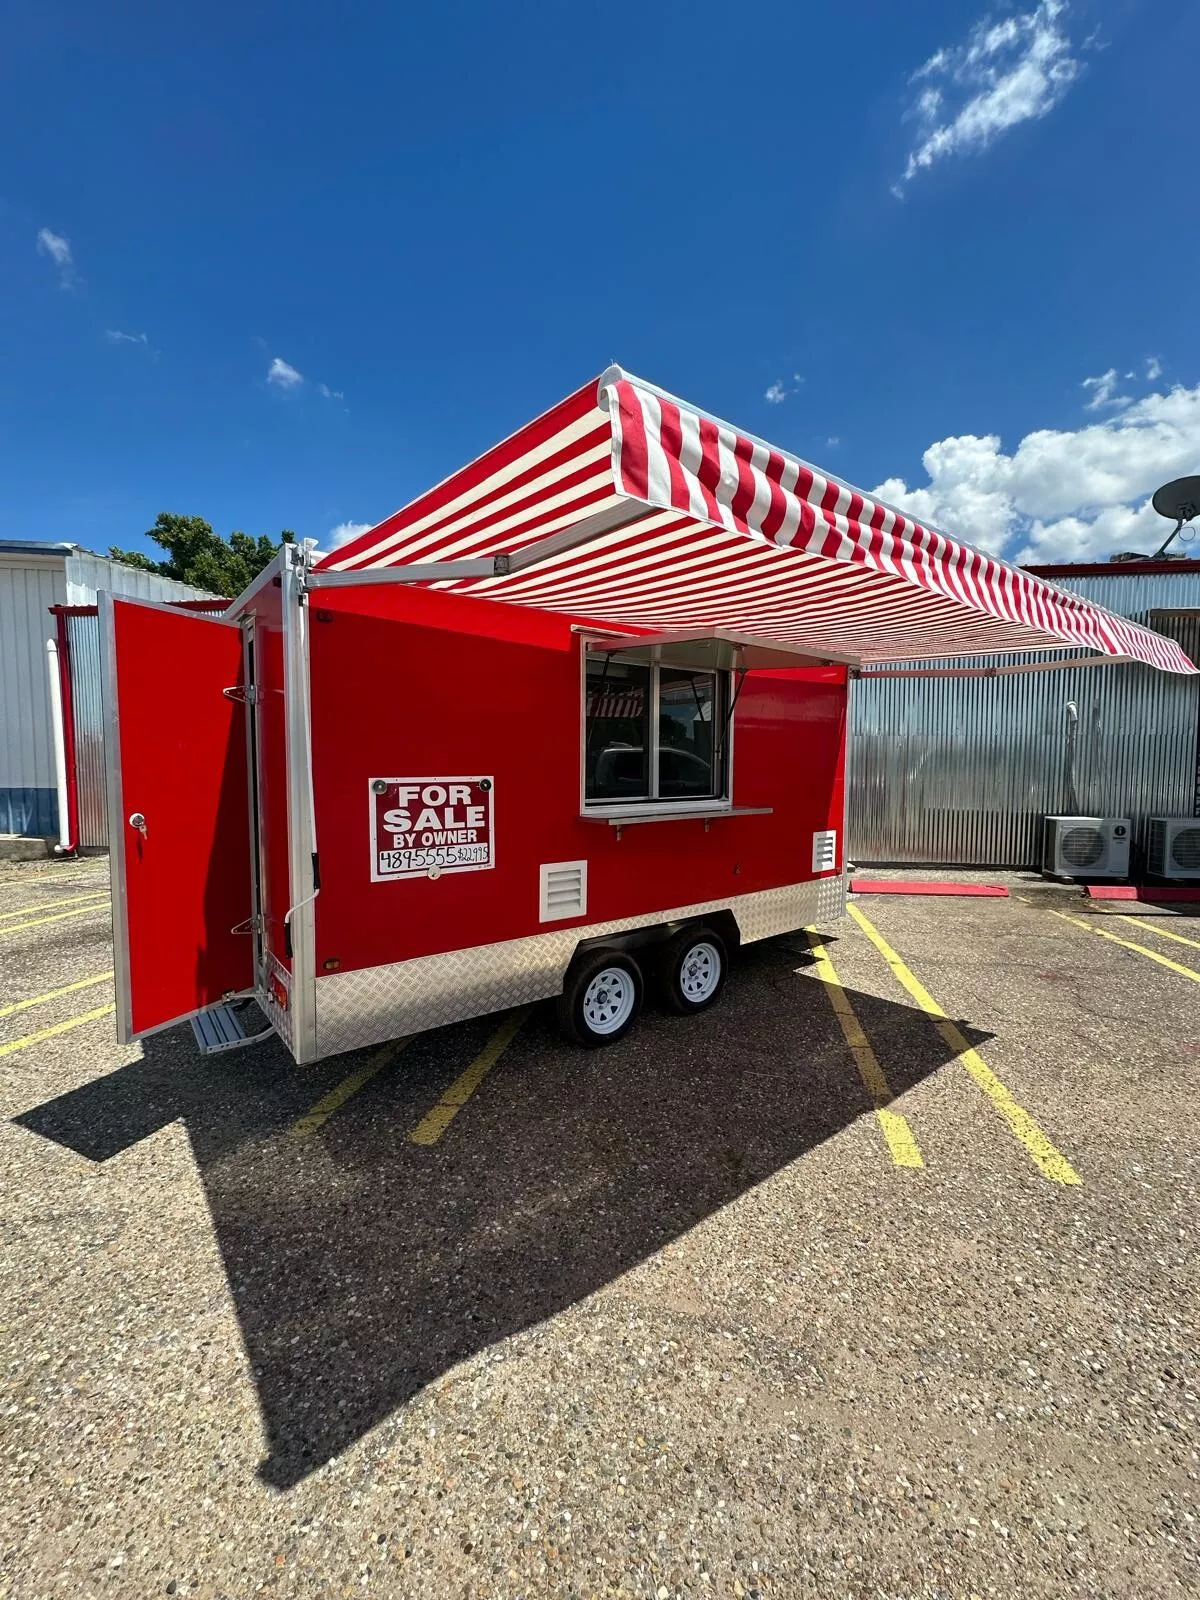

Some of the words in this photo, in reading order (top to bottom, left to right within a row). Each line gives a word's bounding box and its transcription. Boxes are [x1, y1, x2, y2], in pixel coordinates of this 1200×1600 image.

[399, 785, 472, 807] FOR
[383, 806, 485, 833] SALE
[393, 833, 416, 848] BY
[421, 829, 477, 846] OWNER
[380, 847, 457, 868] 489-5555
